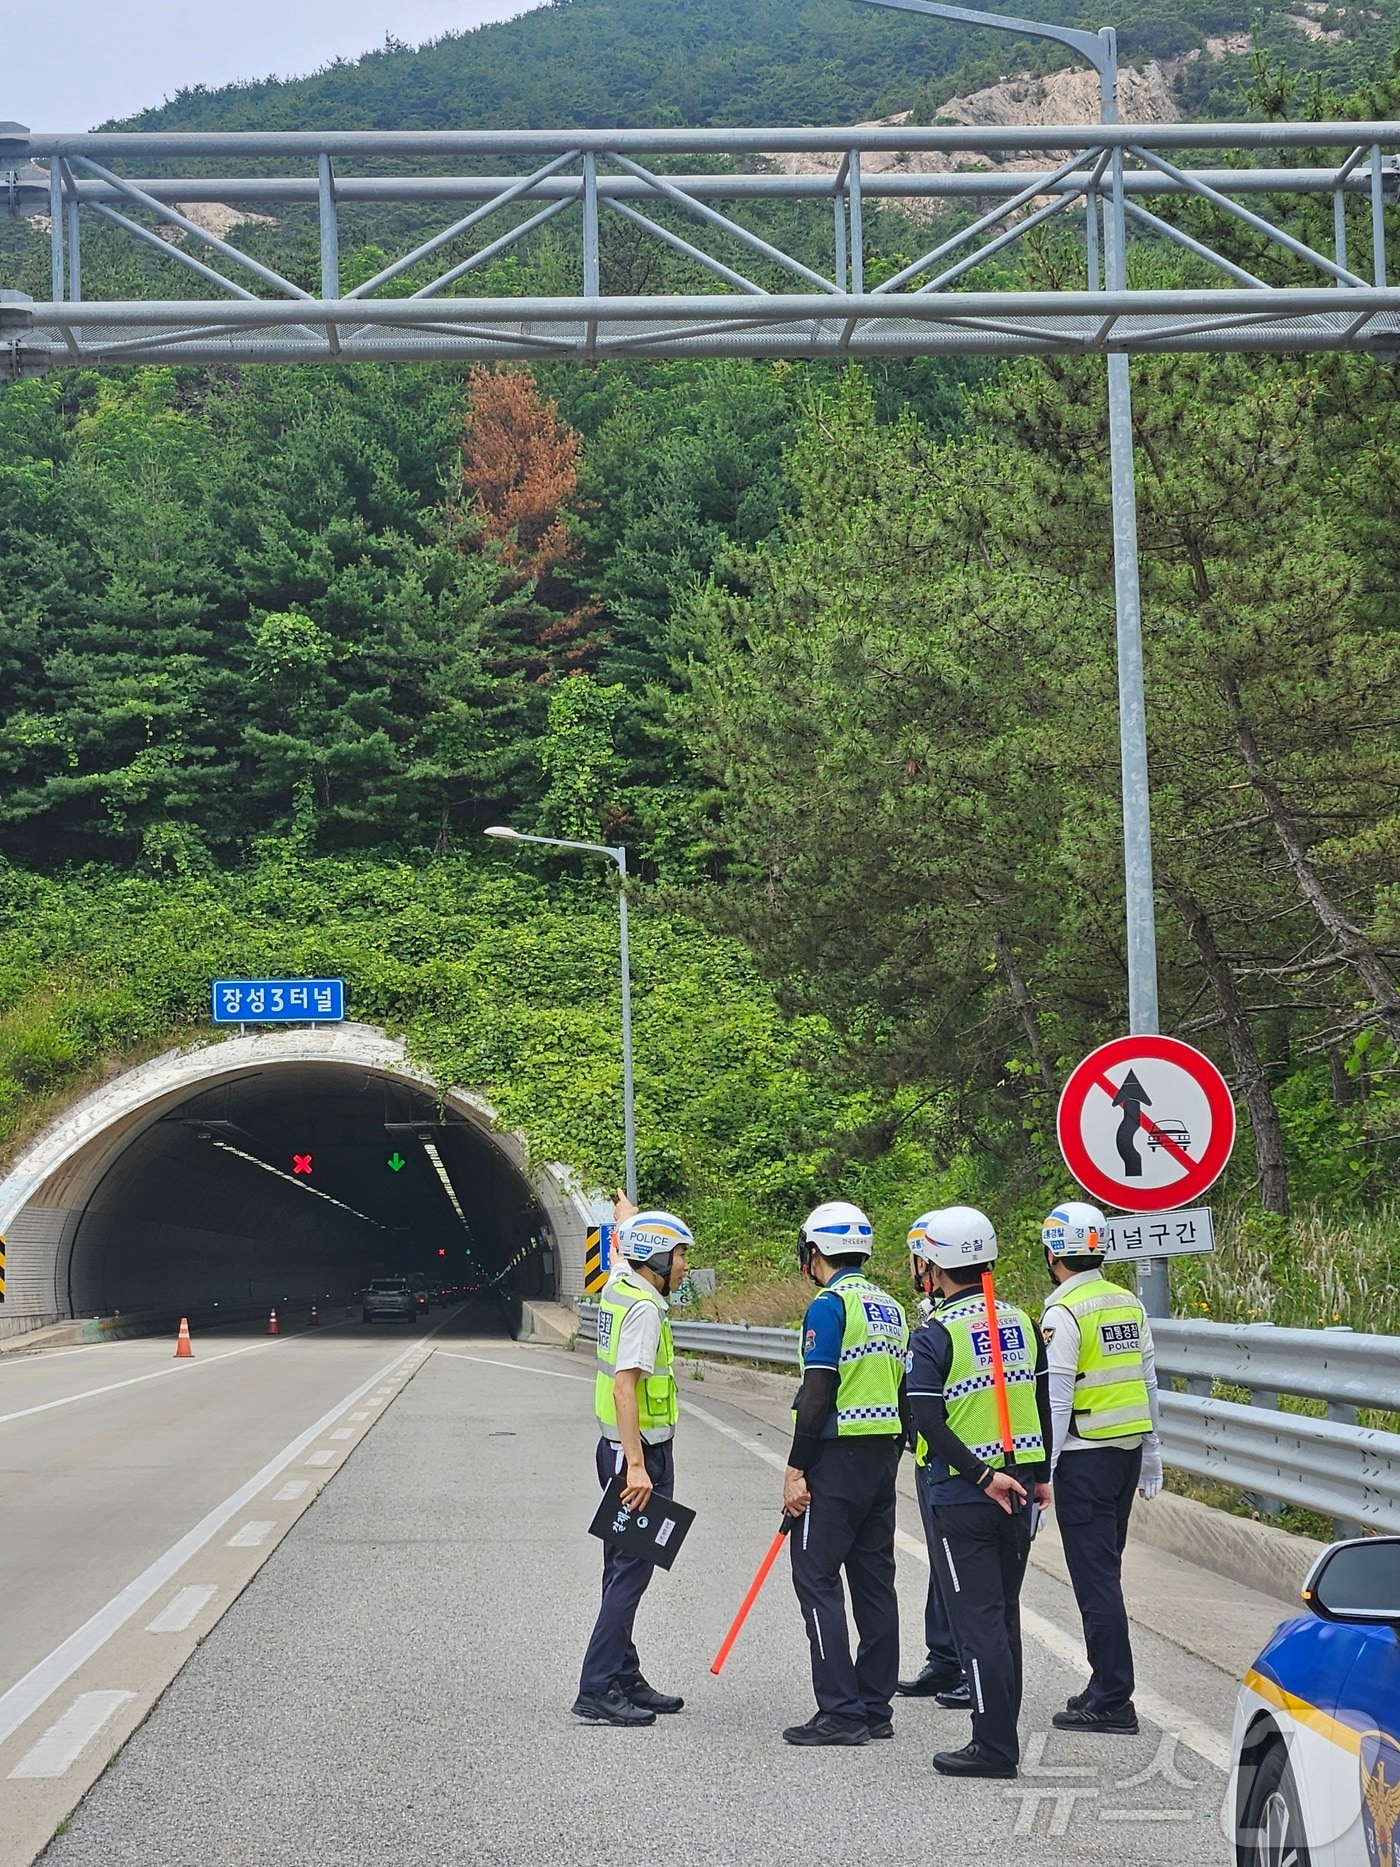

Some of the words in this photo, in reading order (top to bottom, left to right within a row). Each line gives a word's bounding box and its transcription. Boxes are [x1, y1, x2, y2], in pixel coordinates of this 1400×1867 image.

[222, 987, 332, 1014] 장성3터널
[629, 1232, 669, 1247] POLICE
[960, 1239, 984, 1254] 순찰
[868, 1303, 900, 1325] 순찰
[872, 1323, 901, 1336] PATROL
[1105, 1323, 1139, 1341] 교통경찰
[1108, 1340, 1139, 1352] POLICE
[980, 1352, 1024, 1366] PAROL
